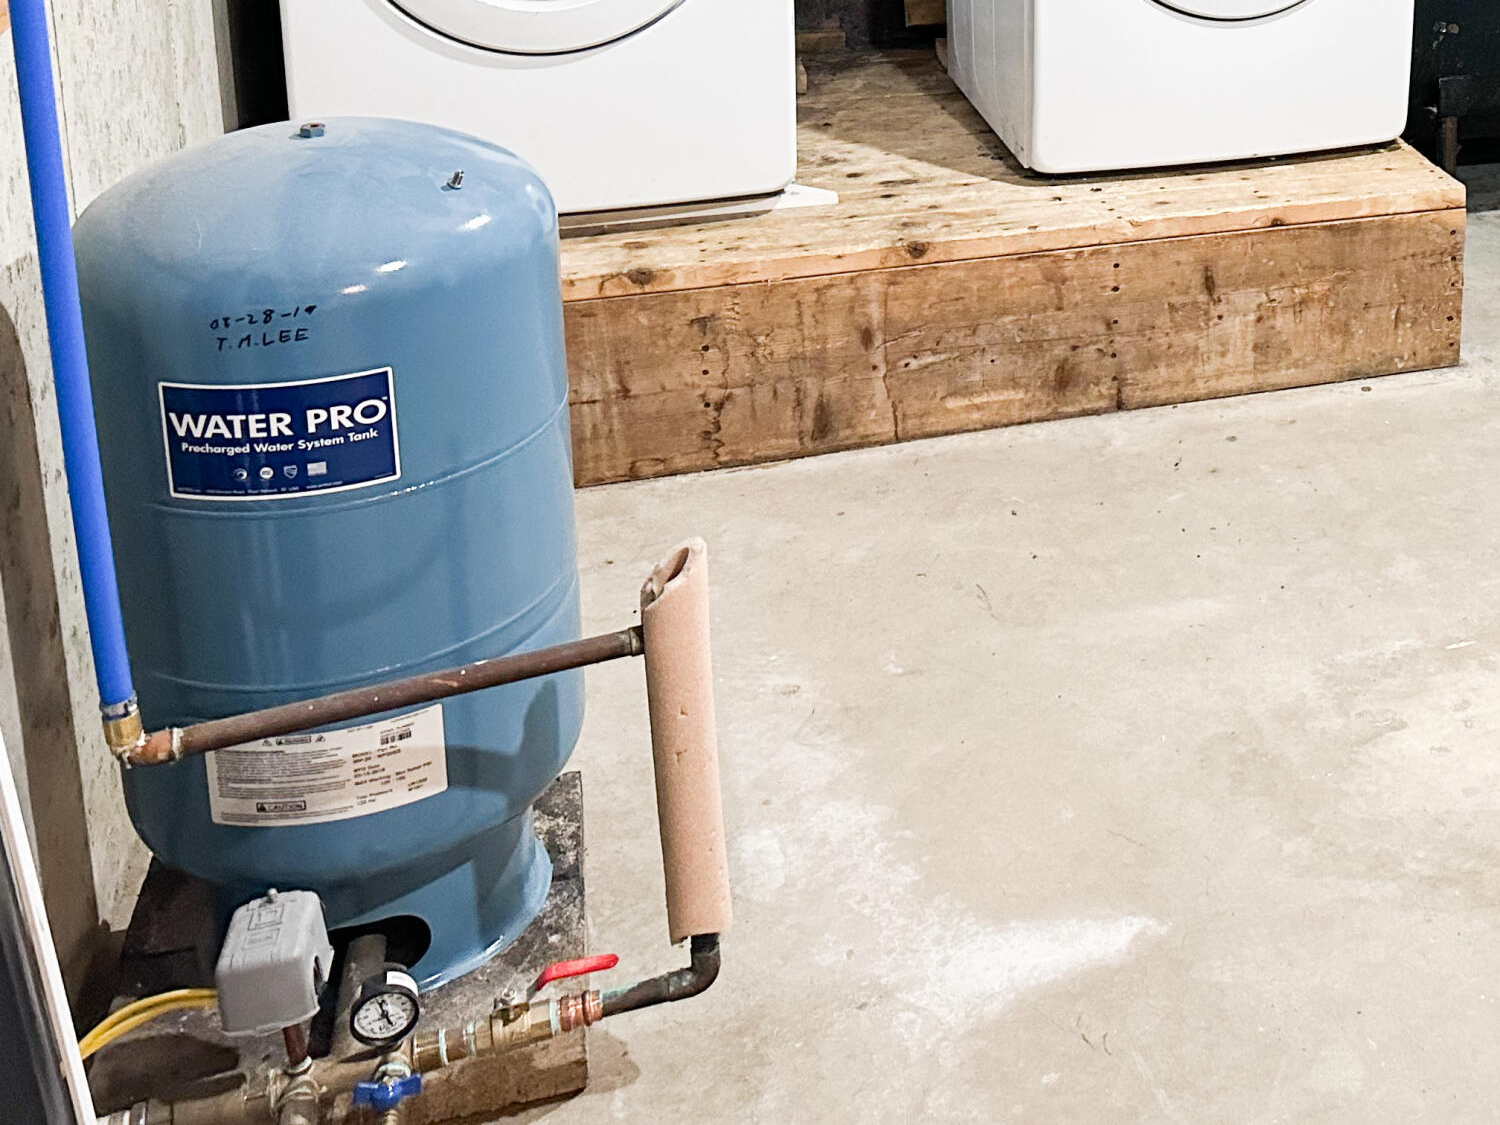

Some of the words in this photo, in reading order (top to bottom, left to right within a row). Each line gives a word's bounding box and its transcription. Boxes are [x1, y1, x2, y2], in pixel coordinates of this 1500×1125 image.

[168, 411, 294, 439] WATER
[305, 398, 387, 434] PRO
[181, 441, 250, 456] Precharged
[253, 442, 295, 454] Water
[297, 435, 345, 451] System
[347, 428, 379, 443] Tank
